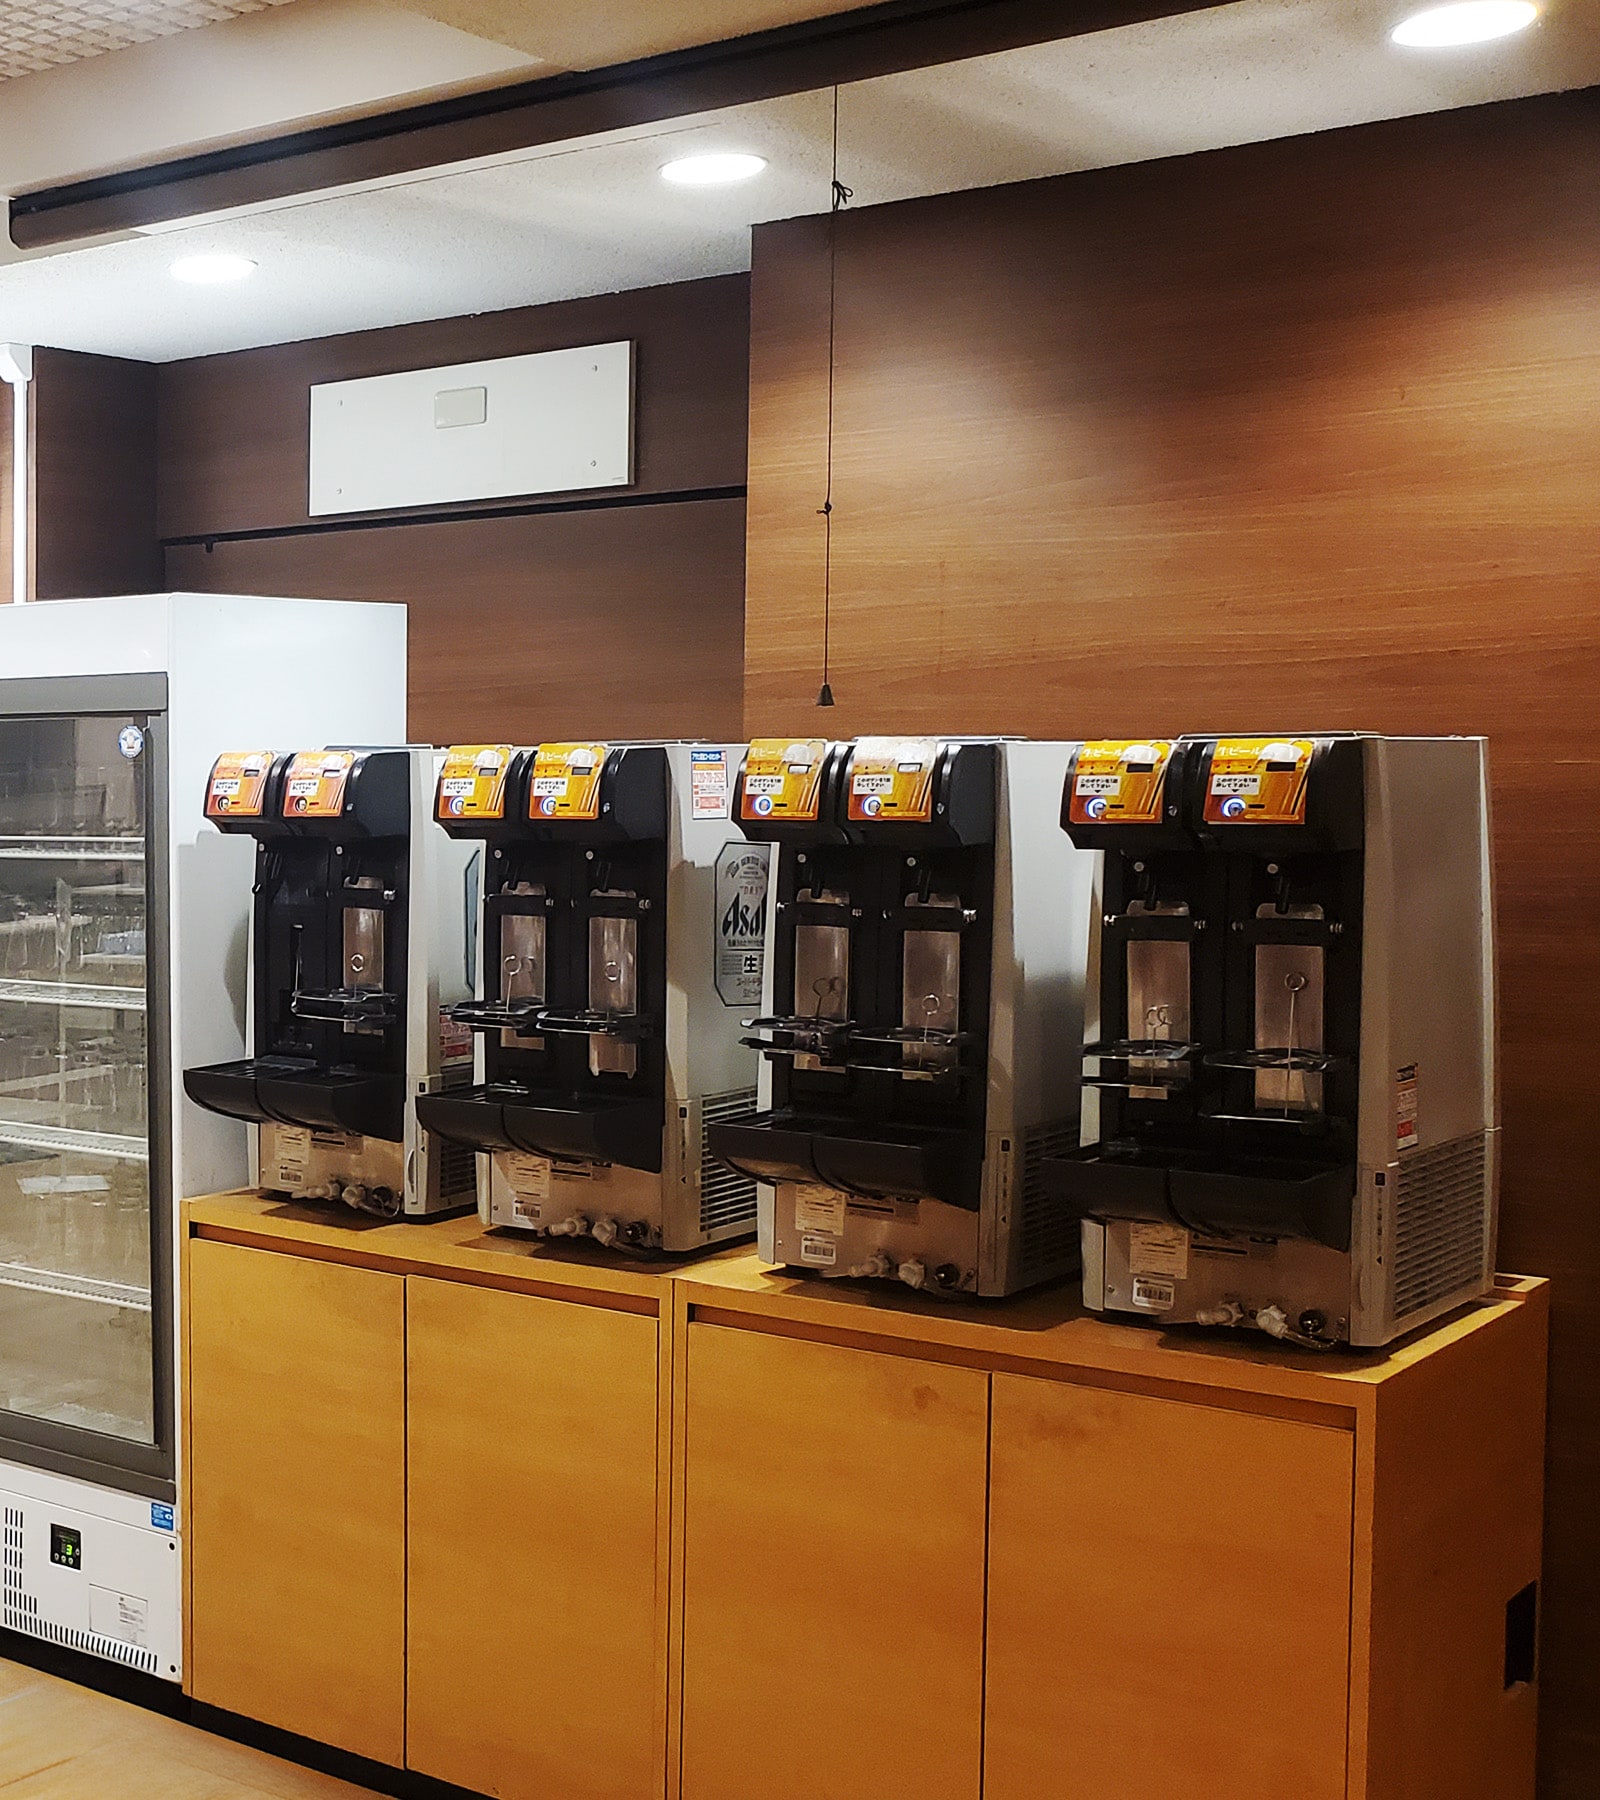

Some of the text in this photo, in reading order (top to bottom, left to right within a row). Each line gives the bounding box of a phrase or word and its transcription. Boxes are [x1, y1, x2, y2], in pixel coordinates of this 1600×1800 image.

[722, 891, 767, 937] Asa
[743, 954, 758, 974] 生
[65, 1544, 73, 1556] 3
